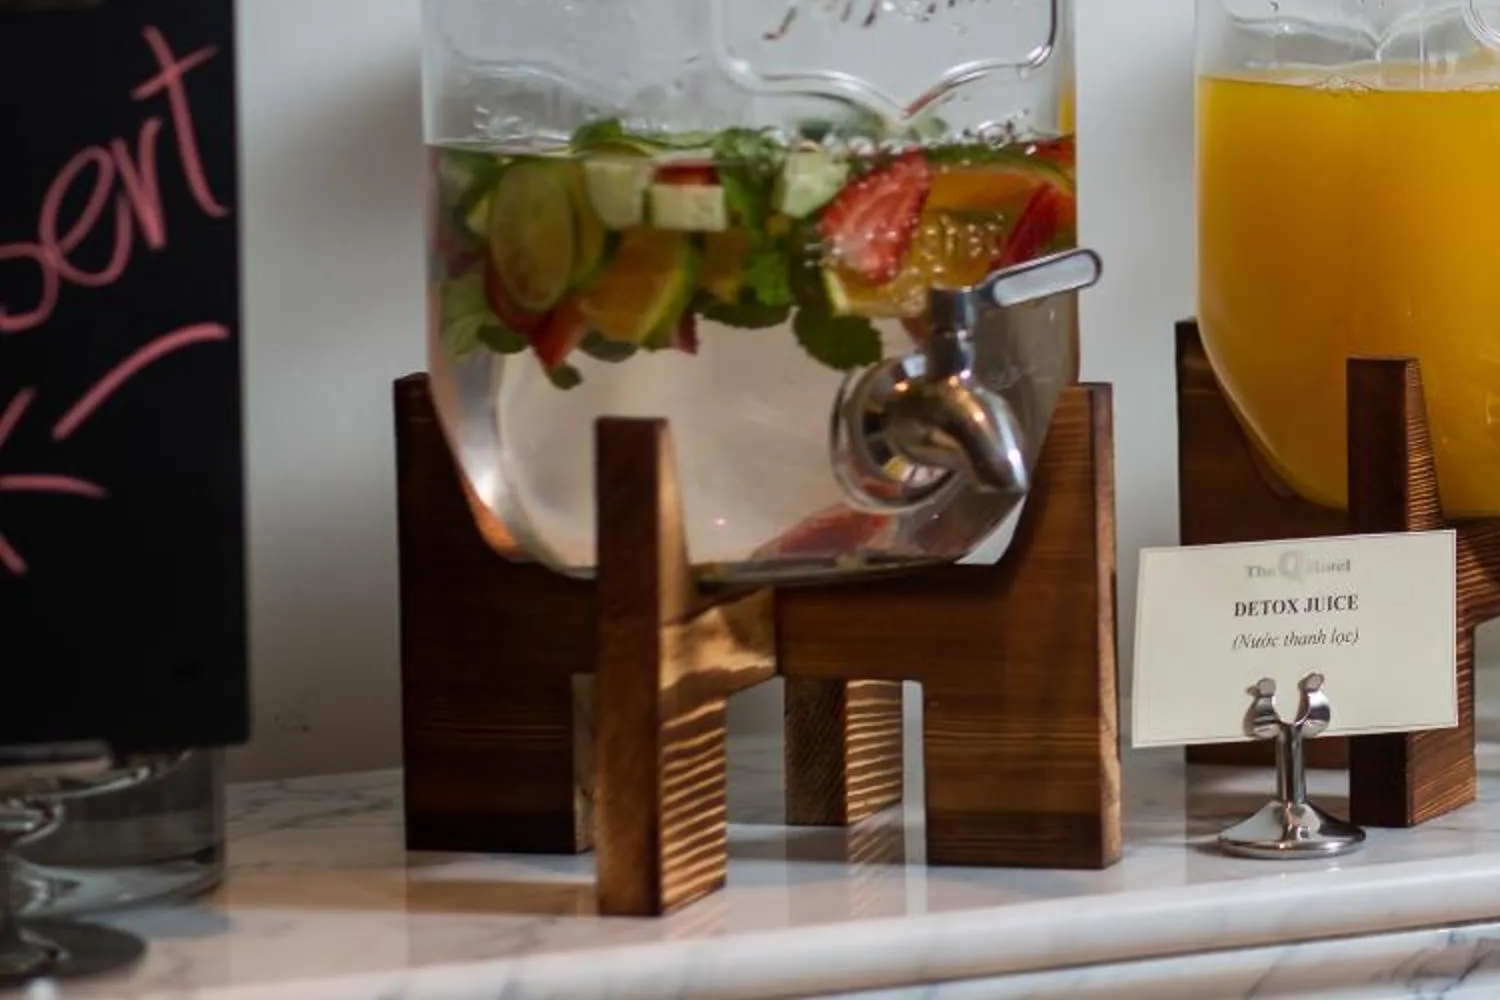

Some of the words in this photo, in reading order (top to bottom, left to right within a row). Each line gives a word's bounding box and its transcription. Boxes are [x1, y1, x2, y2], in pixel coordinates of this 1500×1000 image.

[1244, 564, 1276, 579] The
[1233, 598, 1299, 617] DETOX
[1303, 594, 1360, 613] JUICE
[1283, 628, 1327, 648] thanh
[1330, 626, 1360, 649] lọc)
